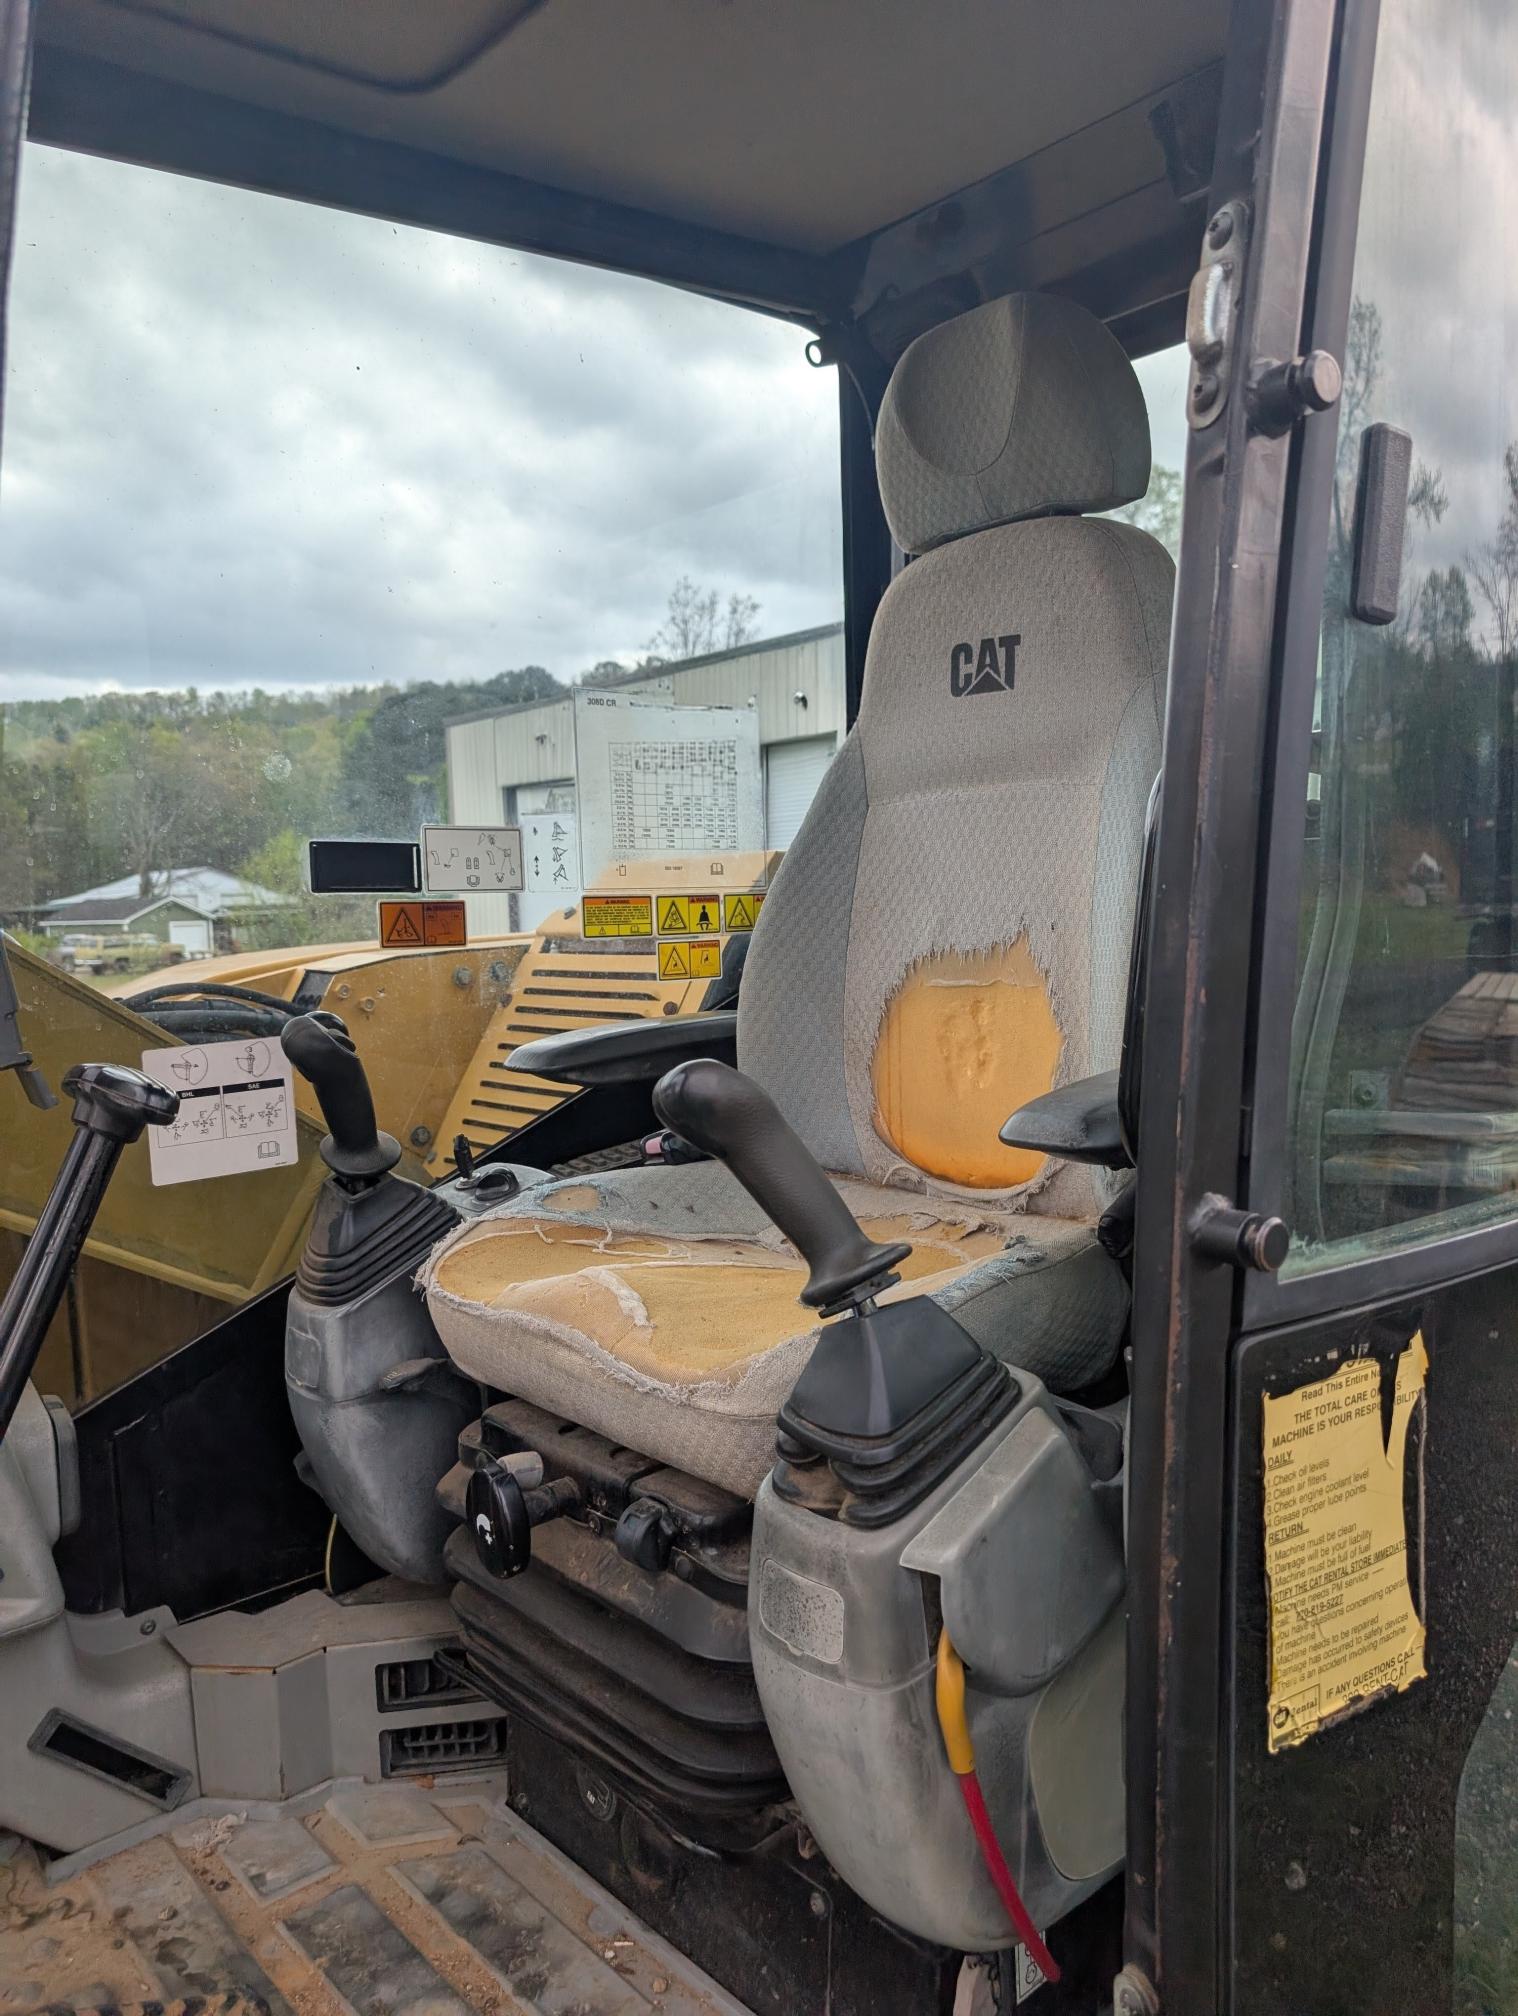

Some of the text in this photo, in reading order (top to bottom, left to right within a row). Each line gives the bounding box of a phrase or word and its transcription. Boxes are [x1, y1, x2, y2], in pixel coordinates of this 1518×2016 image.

[951, 634, 1021, 697] CAT
[1302, 1386, 1322, 1401] Read
[1325, 1380, 1343, 1393] This
[1345, 1372, 1369, 1388] Entire
[1294, 1408, 1312, 1424] THE
[1314, 1400, 1342, 1418] TOTAL
[1344, 1390, 1368, 1406] CARE
[1272, 1424, 1314, 1448] MACHINE
[1317, 1420, 1326, 1432] IS
[1328, 1410, 1352, 1428] YOUR
[1268, 1450, 1292, 1468] DAILY
[1298, 1464, 1308, 1477] oil
[1309, 1458, 1330, 1473] levels
[1297, 1480, 1306, 1492] air
[1308, 1472, 1327, 1488] filters
[1299, 1487, 1324, 1504] engine
[1325, 1476, 1352, 1494] coolant
[1353, 1466, 1370, 1482] level
[1302, 1500, 1326, 1518] proper
[1328, 1492, 1344, 1506] lube
[1345, 1484, 1367, 1502] points
[1268, 1520, 1304, 1546] RETURN
[1307, 1534, 1325, 1548] must
[1326, 1531, 1336, 1542] be
[1338, 1522, 1356, 1538] clean
[1308, 1548, 1319, 1560] will
[1320, 1546, 1330, 1558] be
[1332, 1540, 1348, 1556] your
[1348, 1530, 1372, 1546] liability
[1274, 1570, 1306, 1588] Machine
[1308, 1560, 1325, 1576] must
[1326, 1556, 1336, 1568] be
[1338, 1551, 1348, 1564] full
[1350, 1546, 1358, 1559] of
[1358, 1542, 1370, 1554] fuel
[1274, 1585, 1293, 1604] OTIFY
[1294, 1580, 1308, 1594] THE
[1309, 1574, 1322, 1589] CAT
[1324, 1566, 1349, 1582] RENTAL
[1351, 1554, 1372, 1573] STORE
[1308, 1588, 1330, 1604] needs
[1332, 1580, 1343, 1594] PM
[1345, 1572, 1369, 1588] service
[1292, 1620, 1310, 1634] have
[1310, 1608, 1344, 1628] questions
[1346, 1588, 1384, 1612] concerning
[1276, 1612, 1379, 1666] Machine needs to be repaired
[1276, 1632, 1316, 1654] of machine
[1299, 1672, 1306, 1682] is
[1307, 1668, 1316, 1679] an
[1318, 1654, 1347, 1674] accident
[1348, 1640, 1378, 1660] involving
[1379, 1625, 1406, 1645] machine
[1309, 1654, 1321, 1666] has
[1323, 1638, 1354, 1660] occurred
[1356, 1635, 1362, 1645] to
[1364, 1624, 1383, 1642] safety
[1384, 1612, 1408, 1630] devices
[1326, 1688, 1334, 1700] IF
[1335, 1680, 1352, 1696] ANY
[1352, 1656, 1396, 1688] QUESTIONS
[1396, 1646, 1416, 1664] CALL
